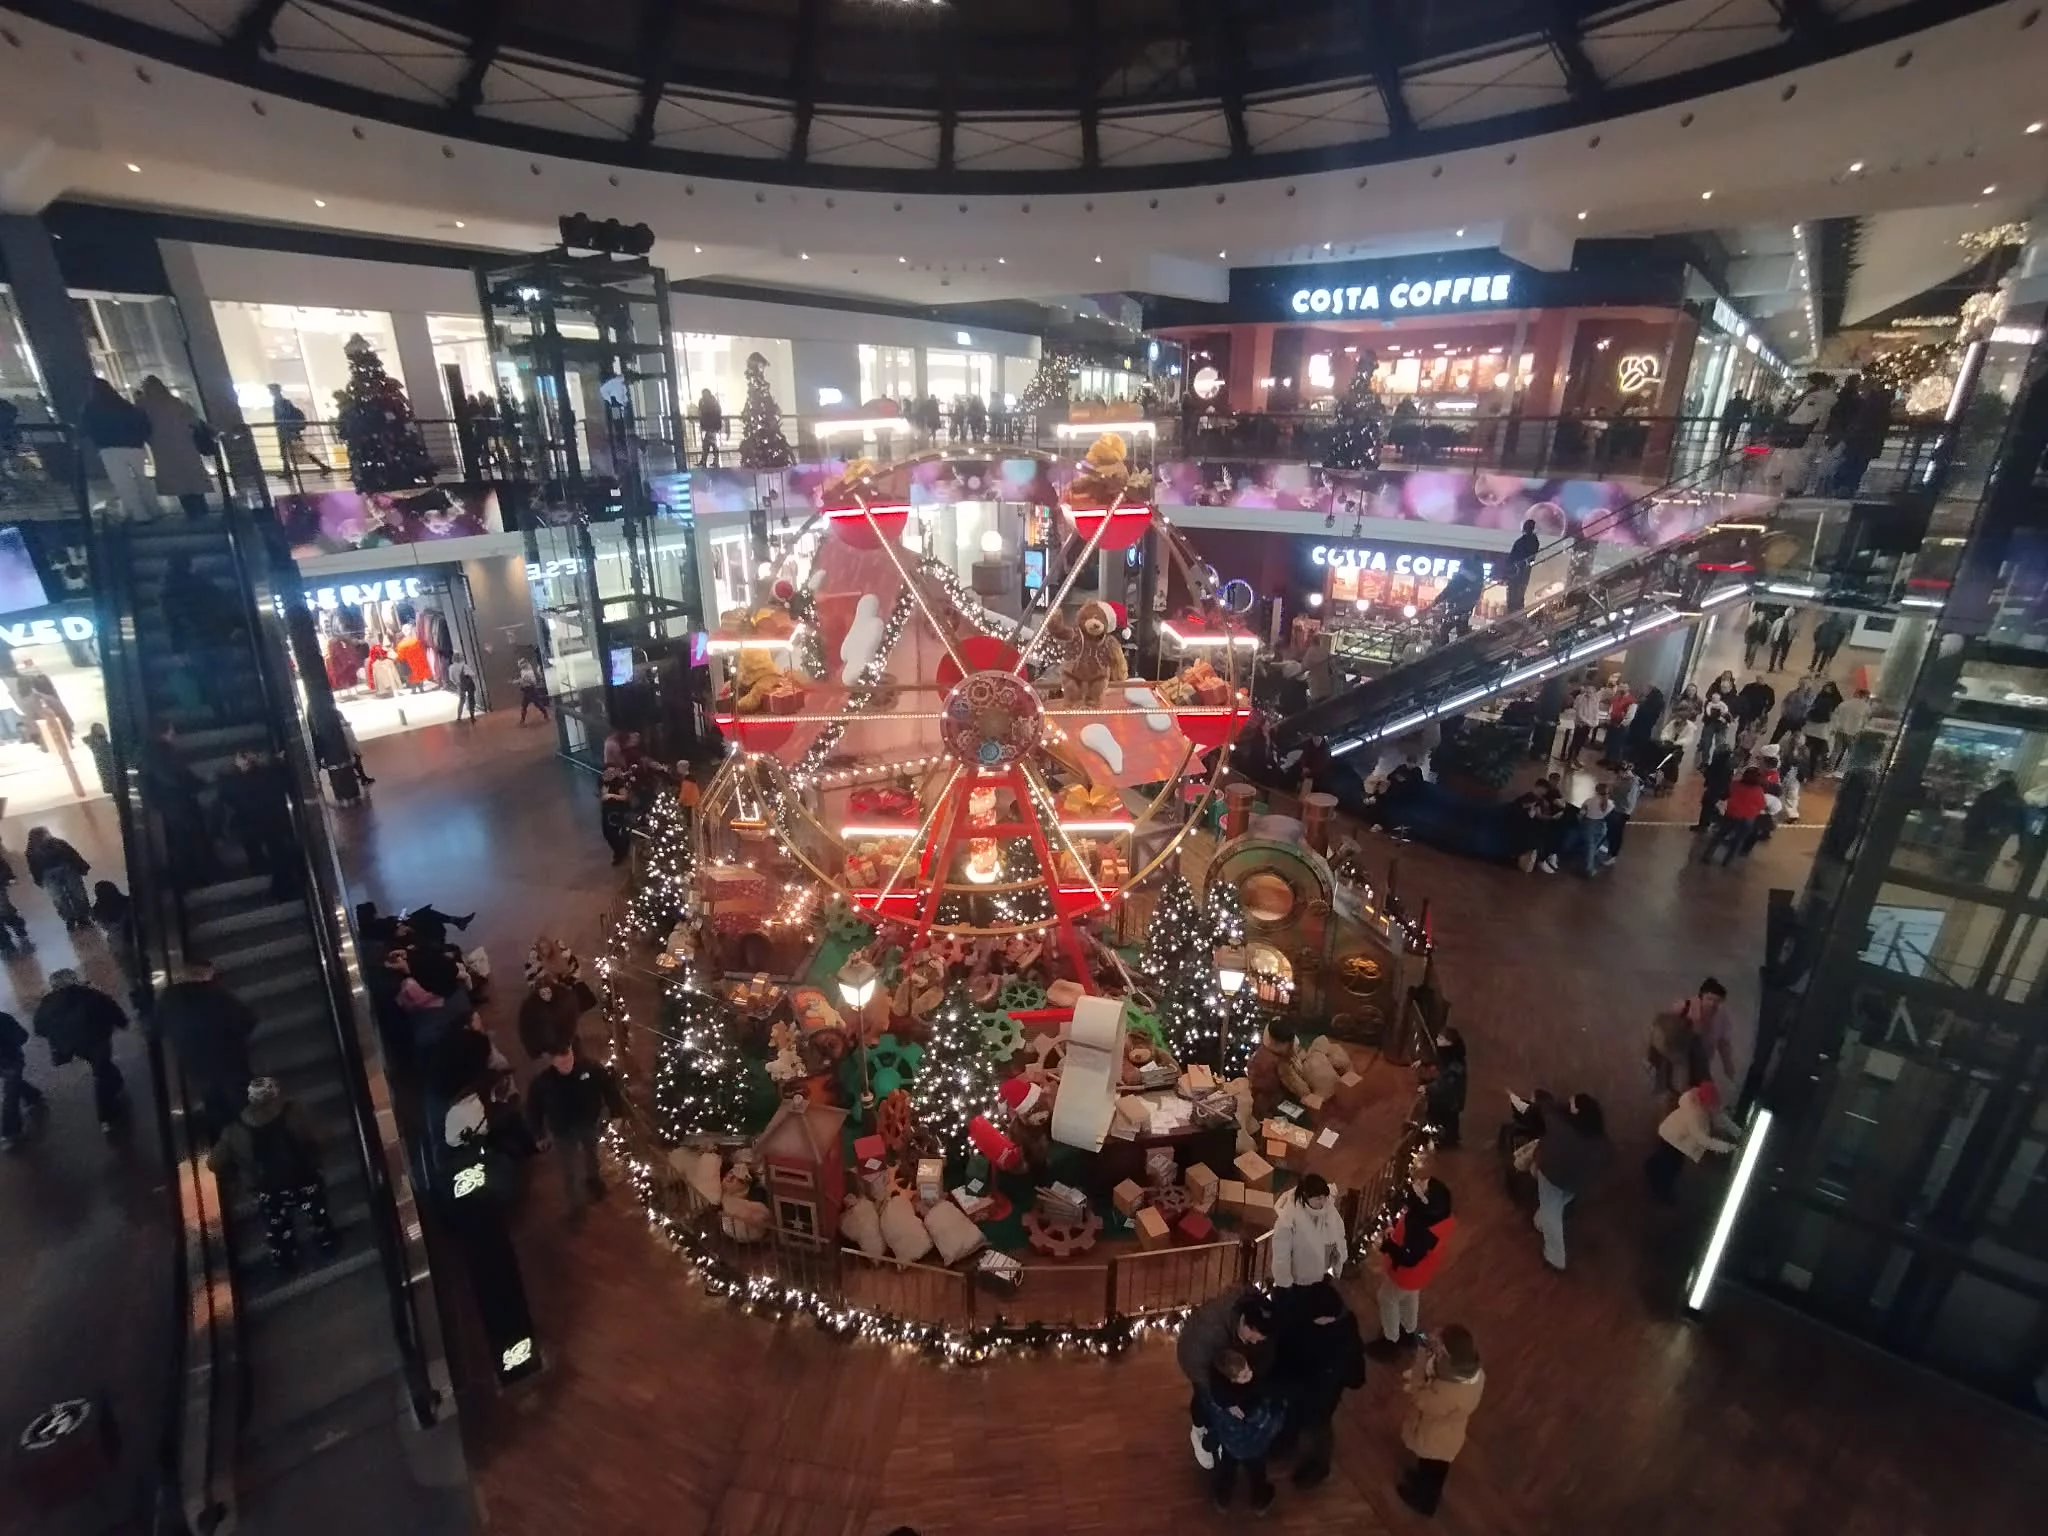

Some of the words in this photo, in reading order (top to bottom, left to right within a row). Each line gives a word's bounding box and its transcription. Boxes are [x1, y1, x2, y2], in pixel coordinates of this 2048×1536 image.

[1292, 286, 1379, 314] COSTA
[1390, 275, 1511, 308] COFFEE
[1312, 546, 1387, 570] COSTA
